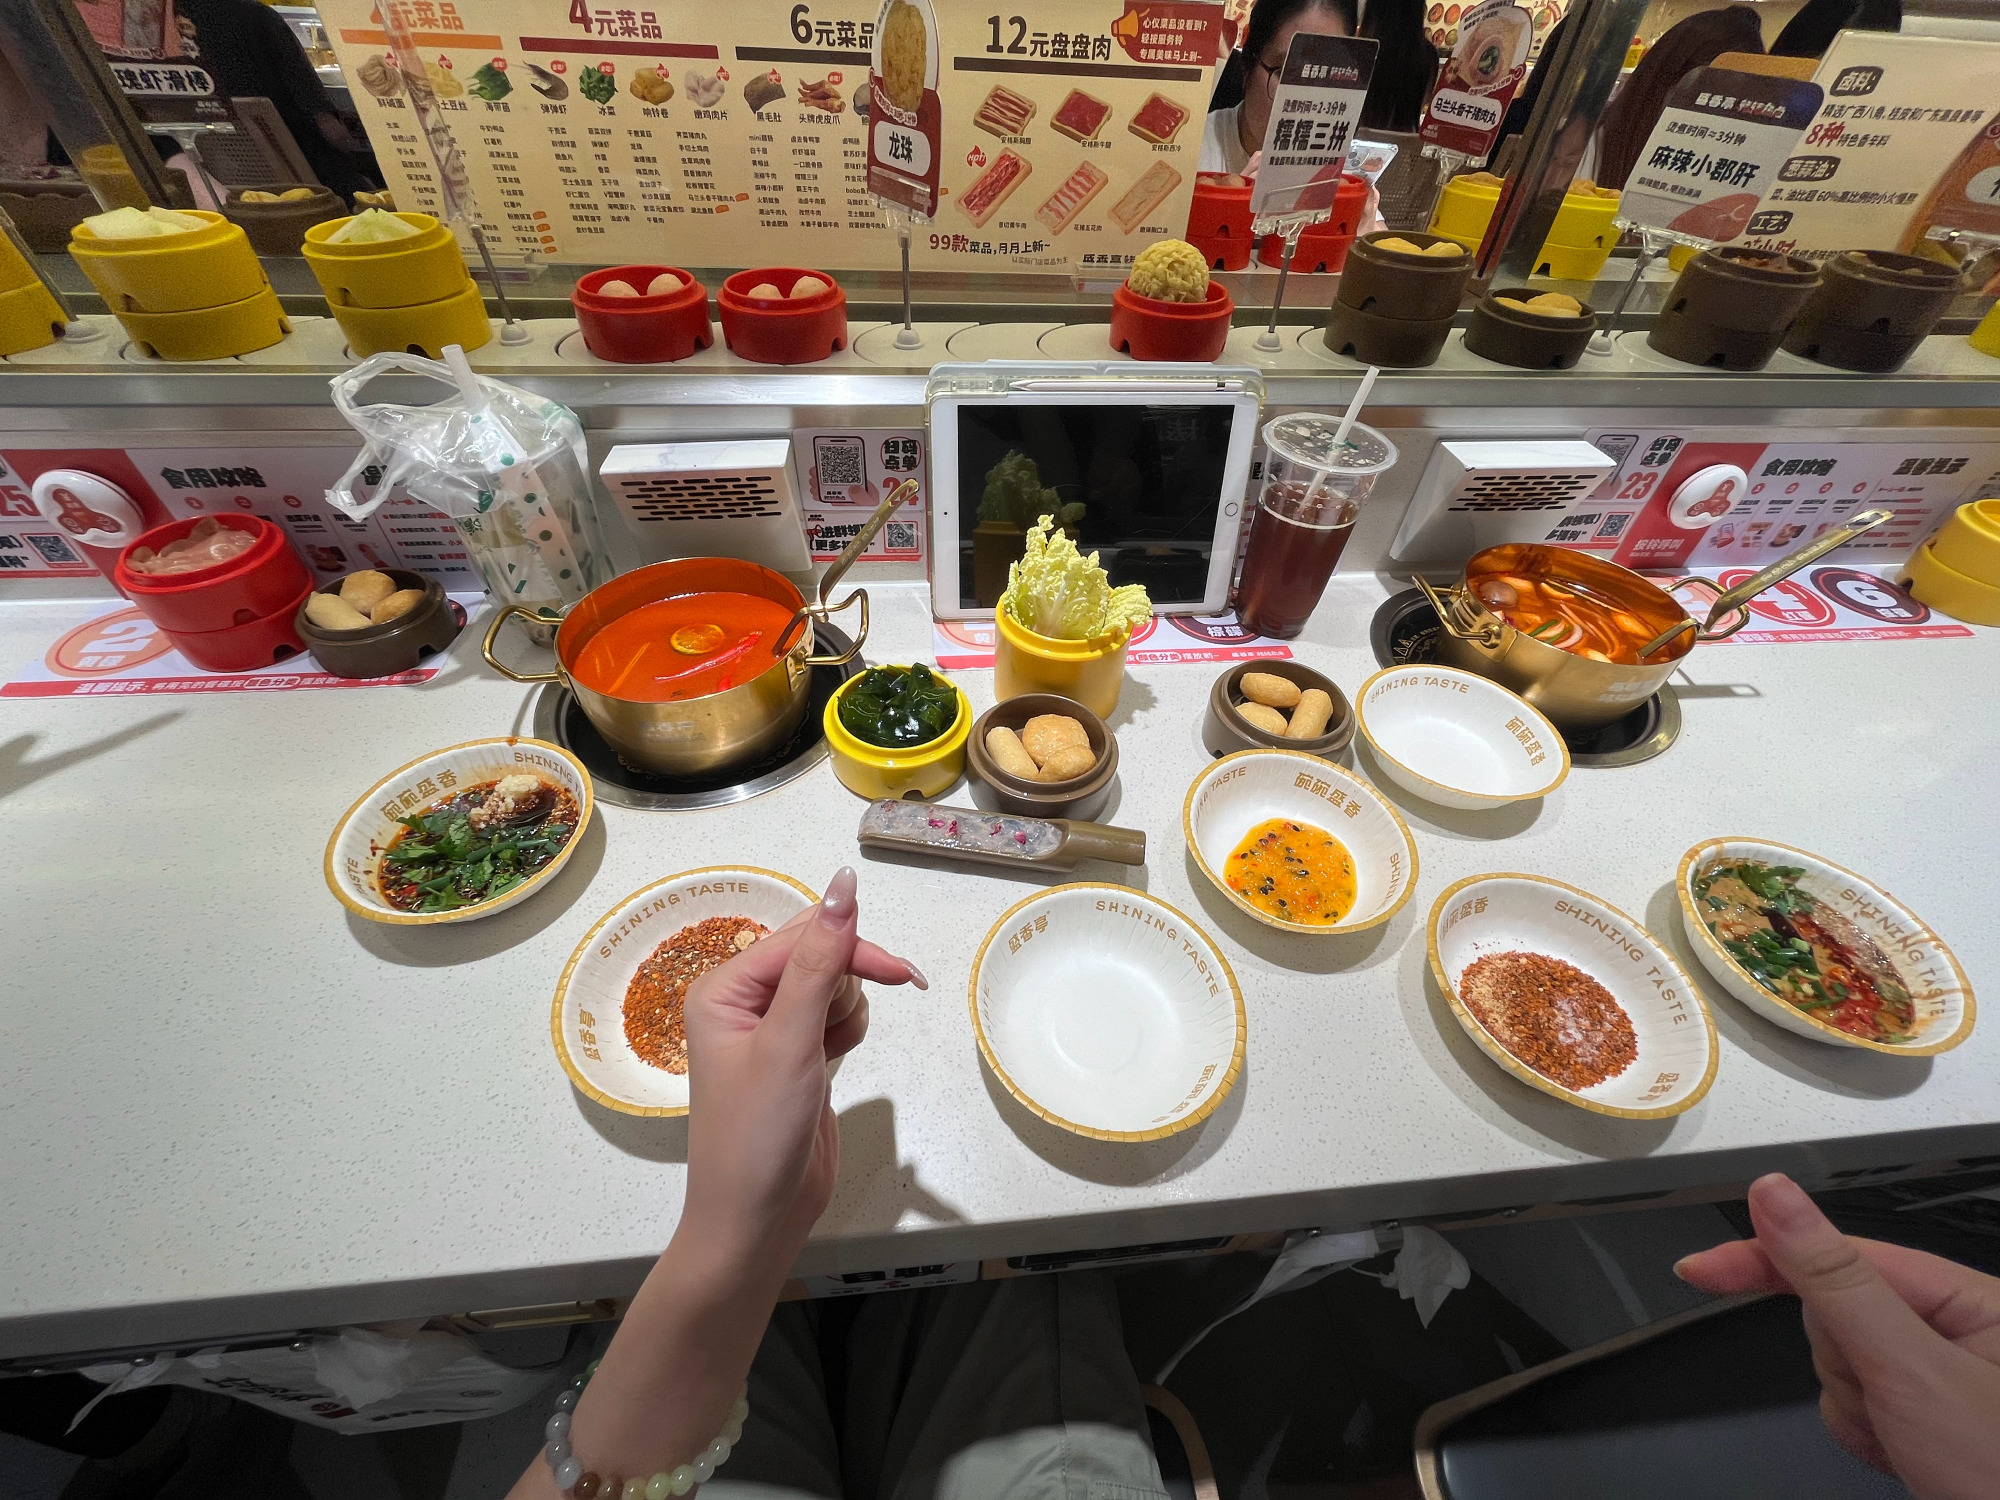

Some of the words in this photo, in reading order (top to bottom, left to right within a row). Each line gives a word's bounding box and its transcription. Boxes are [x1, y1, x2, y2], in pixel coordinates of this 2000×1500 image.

[568, 0, 662, 39] 4元菜品
[790, 3, 875, 49] 6元菜品
[1143, 18, 1207, 31] 心仪菜品没看到?
[986, 15, 1112, 61] 12元盘盘肉
[1141, 33, 1183, 46] 轻按服务铃
[484, 101, 511, 112] 海带苗
[540, 103, 567, 115] 弹弹虾
[597, 105, 616, 116] 冰菜
[642, 107, 669, 118] 响铃卷
[693, 109, 728, 120] 嫩鸡肉片
[756, 112, 782, 123] 黑毛肚
[799, 113, 840, 125] 头牌虎皮爪
[1433, 97, 1497, 125] 马兰头香干猪肉丸
[888, 131, 914, 164] 龙珠
[1273, 117, 1350, 152] 糯糯三拼
[1647, 145, 1761, 188] 麻辣小郡肝
[884, 439, 917, 454] 扫码
[885, 455, 917, 470] 点单
[1761, 458, 1838, 477] 食用攻略
[160, 466, 267, 489] 食用攻略
[1616, 471, 1659, 499] 23
[1424, 676, 1470, 694] TASTE
[514, 752, 574, 784] SHINING
[1210, 766, 1247, 792] TASTE
[380, 768, 458, 823] 碗碗盛香
[1293, 771, 1362, 819] 碗碗盛香
[600, 893, 681, 960] SHINING
[686, 882, 749, 899] TASTE
[1007, 913, 1050, 955] 盛香亭
[1839, 887, 1926, 963] SHINING
[1095, 900, 1178, 942] SHINING
[1182, 939, 1219, 998] TASTE
[1554, 900, 1645, 962] SHINING
[1645, 966, 1688, 1026] TASTE
[578, 1008, 602, 1062] 盛香亭
